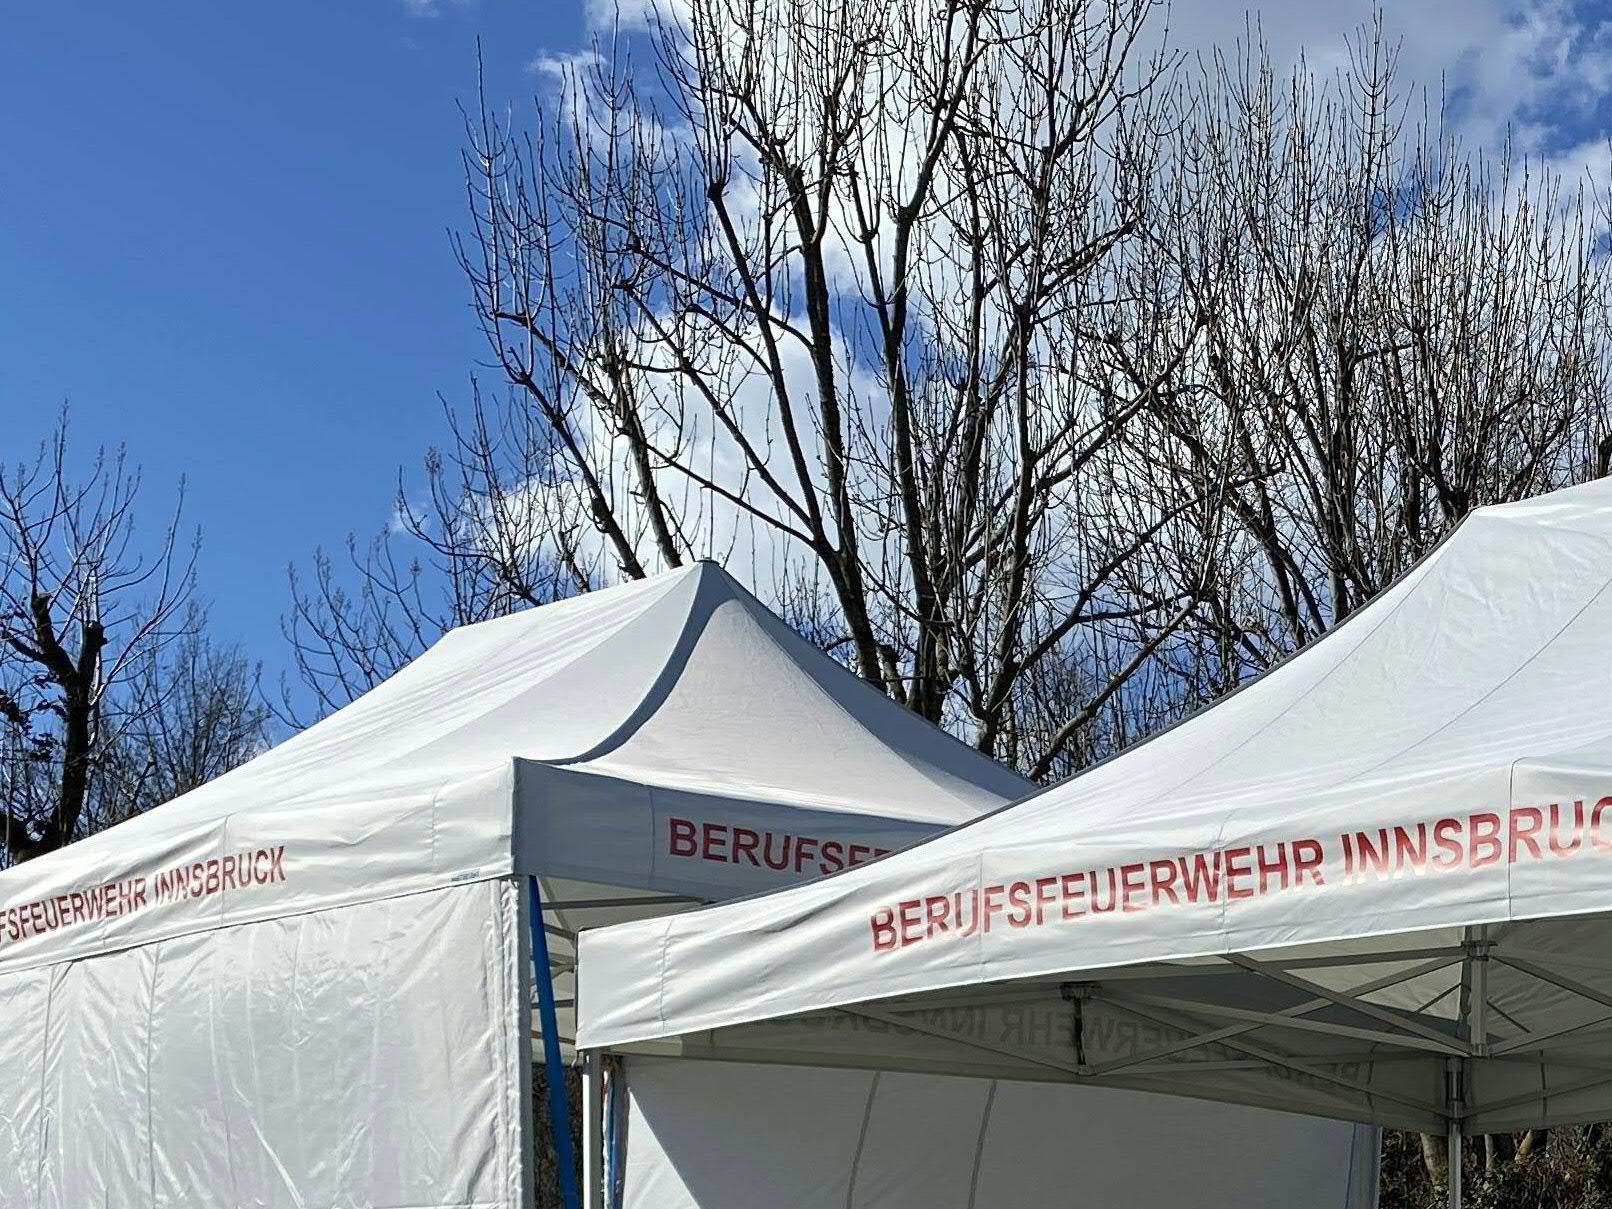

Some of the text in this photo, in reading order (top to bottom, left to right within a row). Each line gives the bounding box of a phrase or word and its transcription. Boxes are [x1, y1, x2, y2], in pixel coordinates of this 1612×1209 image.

[154, 846, 286, 905] INNSBRUCK
[669, 817, 893, 875] BERUFSF
[869, 838, 1326, 952] BERUFSFEUERWEHR
